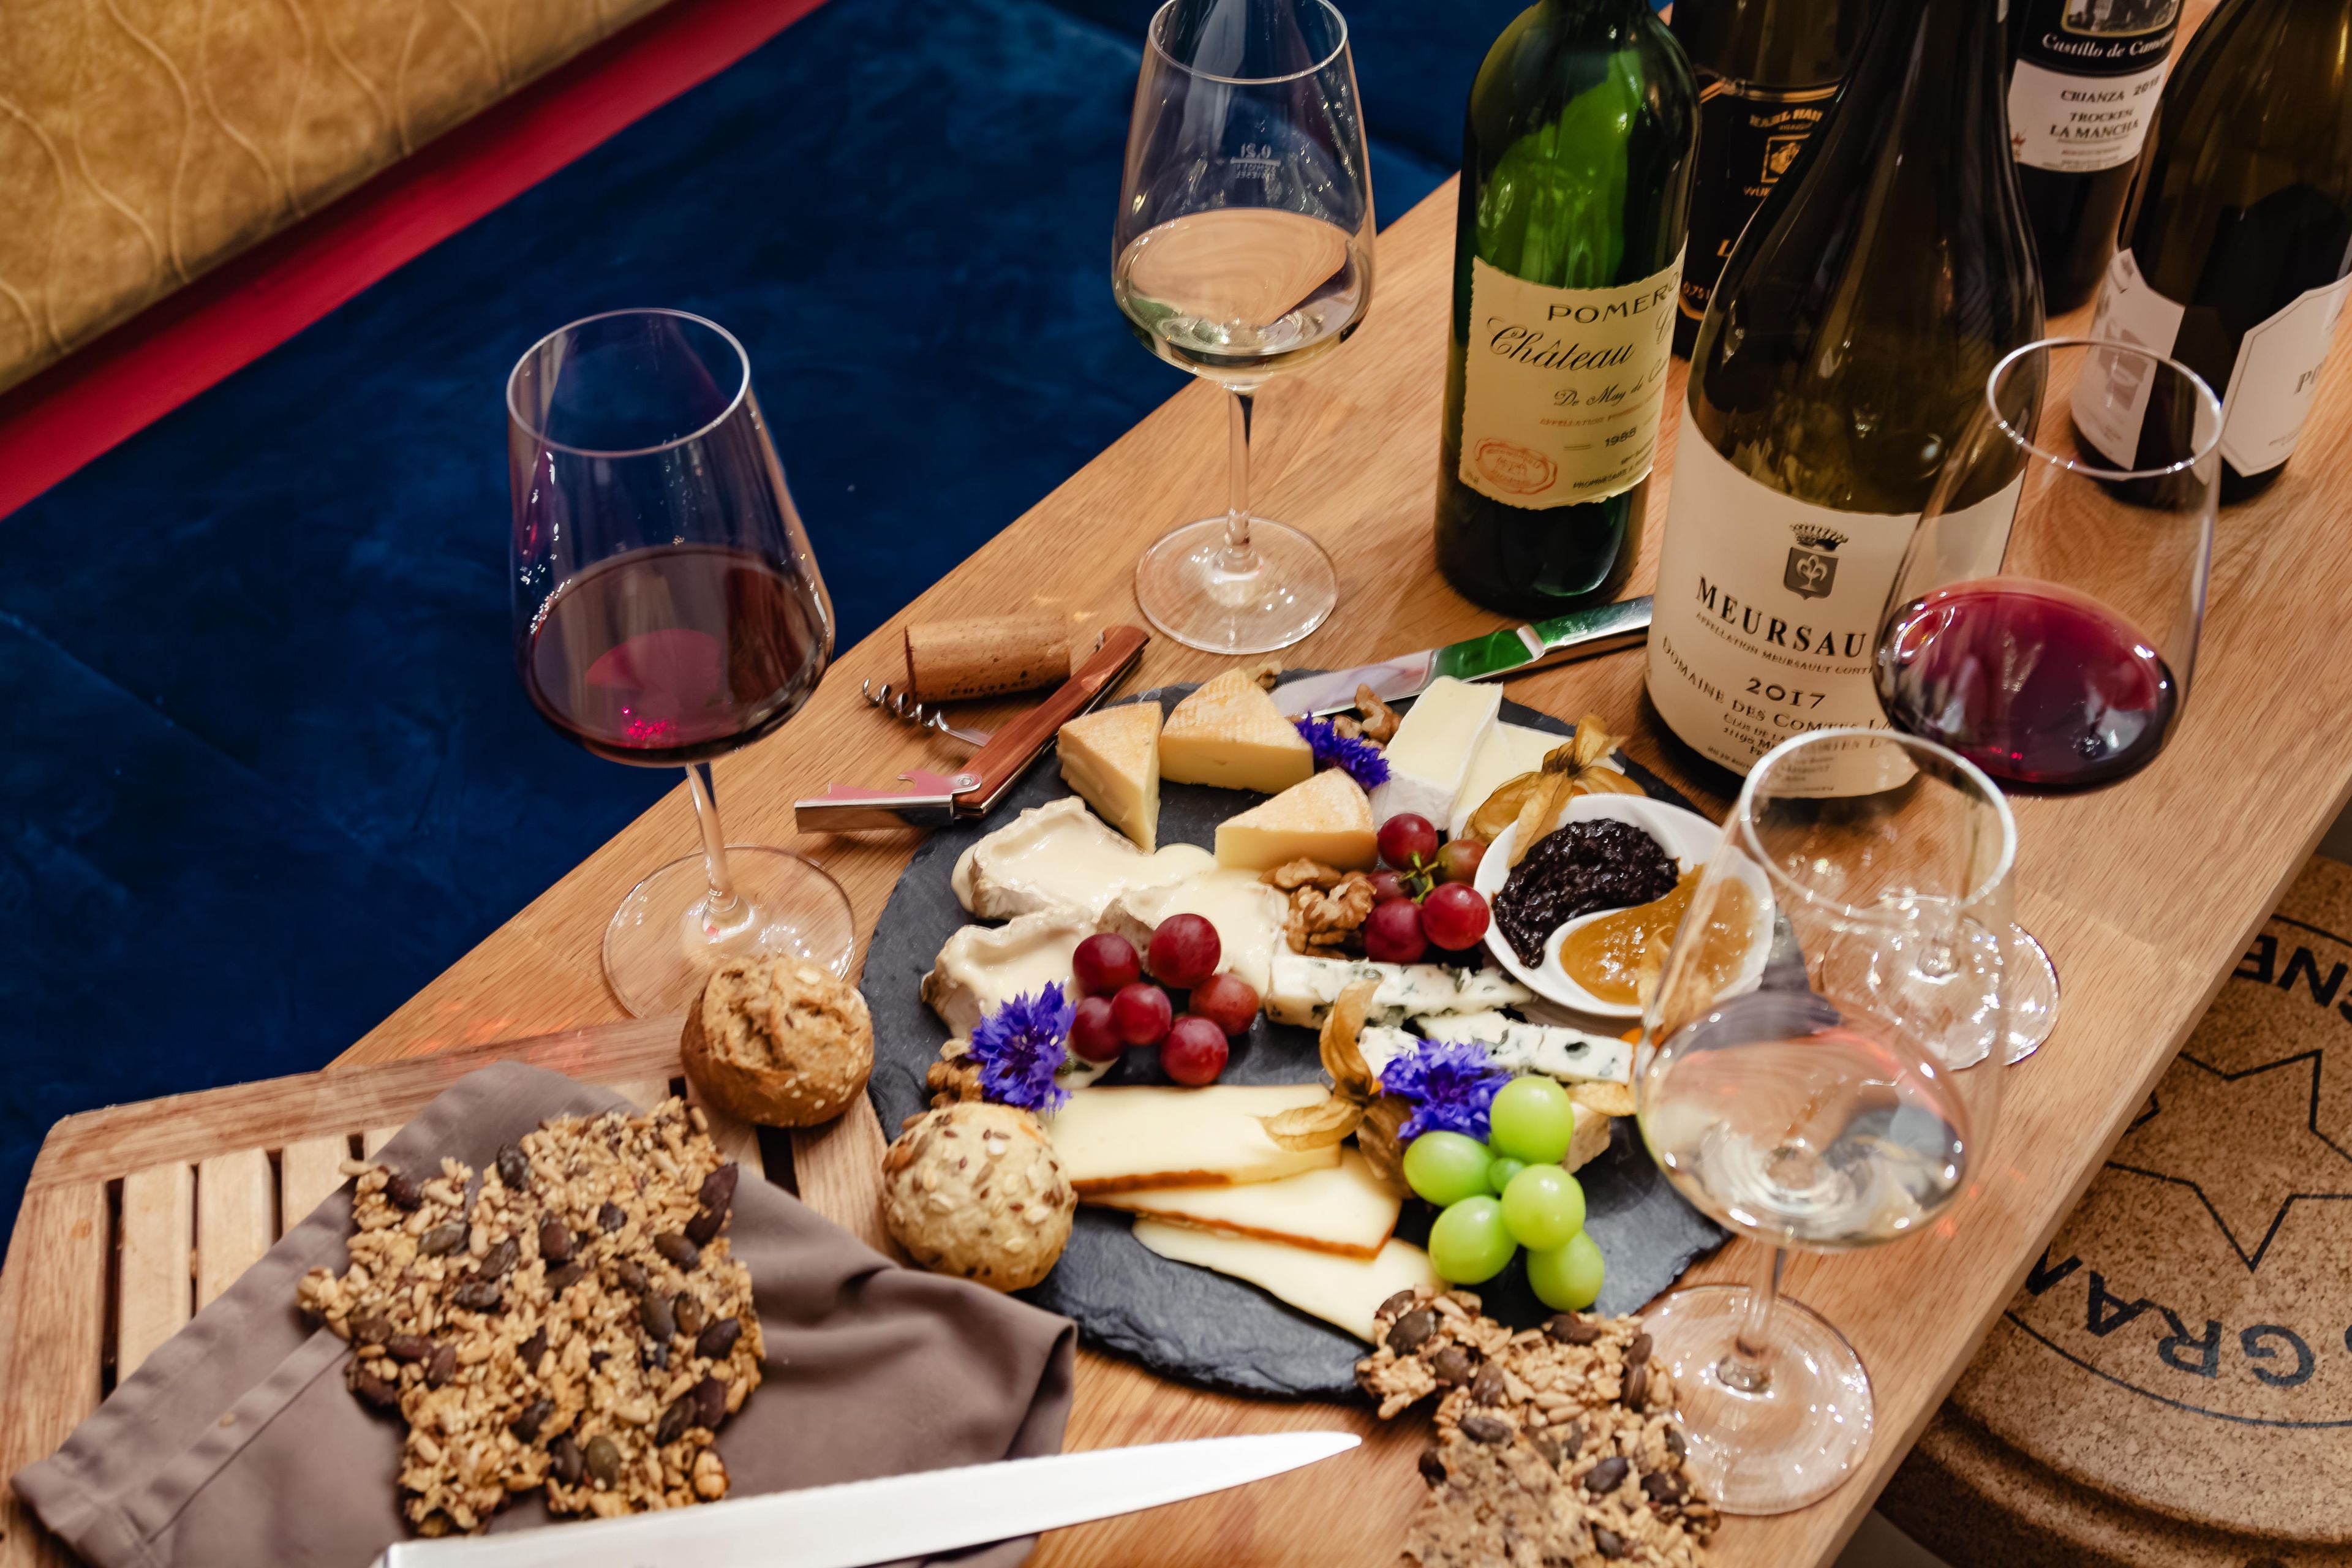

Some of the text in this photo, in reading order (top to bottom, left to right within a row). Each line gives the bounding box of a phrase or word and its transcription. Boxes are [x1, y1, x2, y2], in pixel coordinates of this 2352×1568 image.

[2042, 33, 2103, 58] Castillo
[2106, 42, 2126, 58] de
[2060, 89, 2125, 103] CRIANZA
[2070, 107, 2135, 123] TROCKEN
[2049, 118, 2138, 139] LA MANCHA
[1548, 271, 1682, 323] POMERO
[1487, 315, 1637, 371] Château
[1695, 575, 1867, 658] MEURSAU
[1695, 611, 1759, 656] APPELLATION
[1762, 650, 1832, 676] MEURSAULT
[1662, 635, 1725, 704] DOMAINE
[1732, 699, 1766, 722] DES
[1746, 676, 1827, 709] 2017
